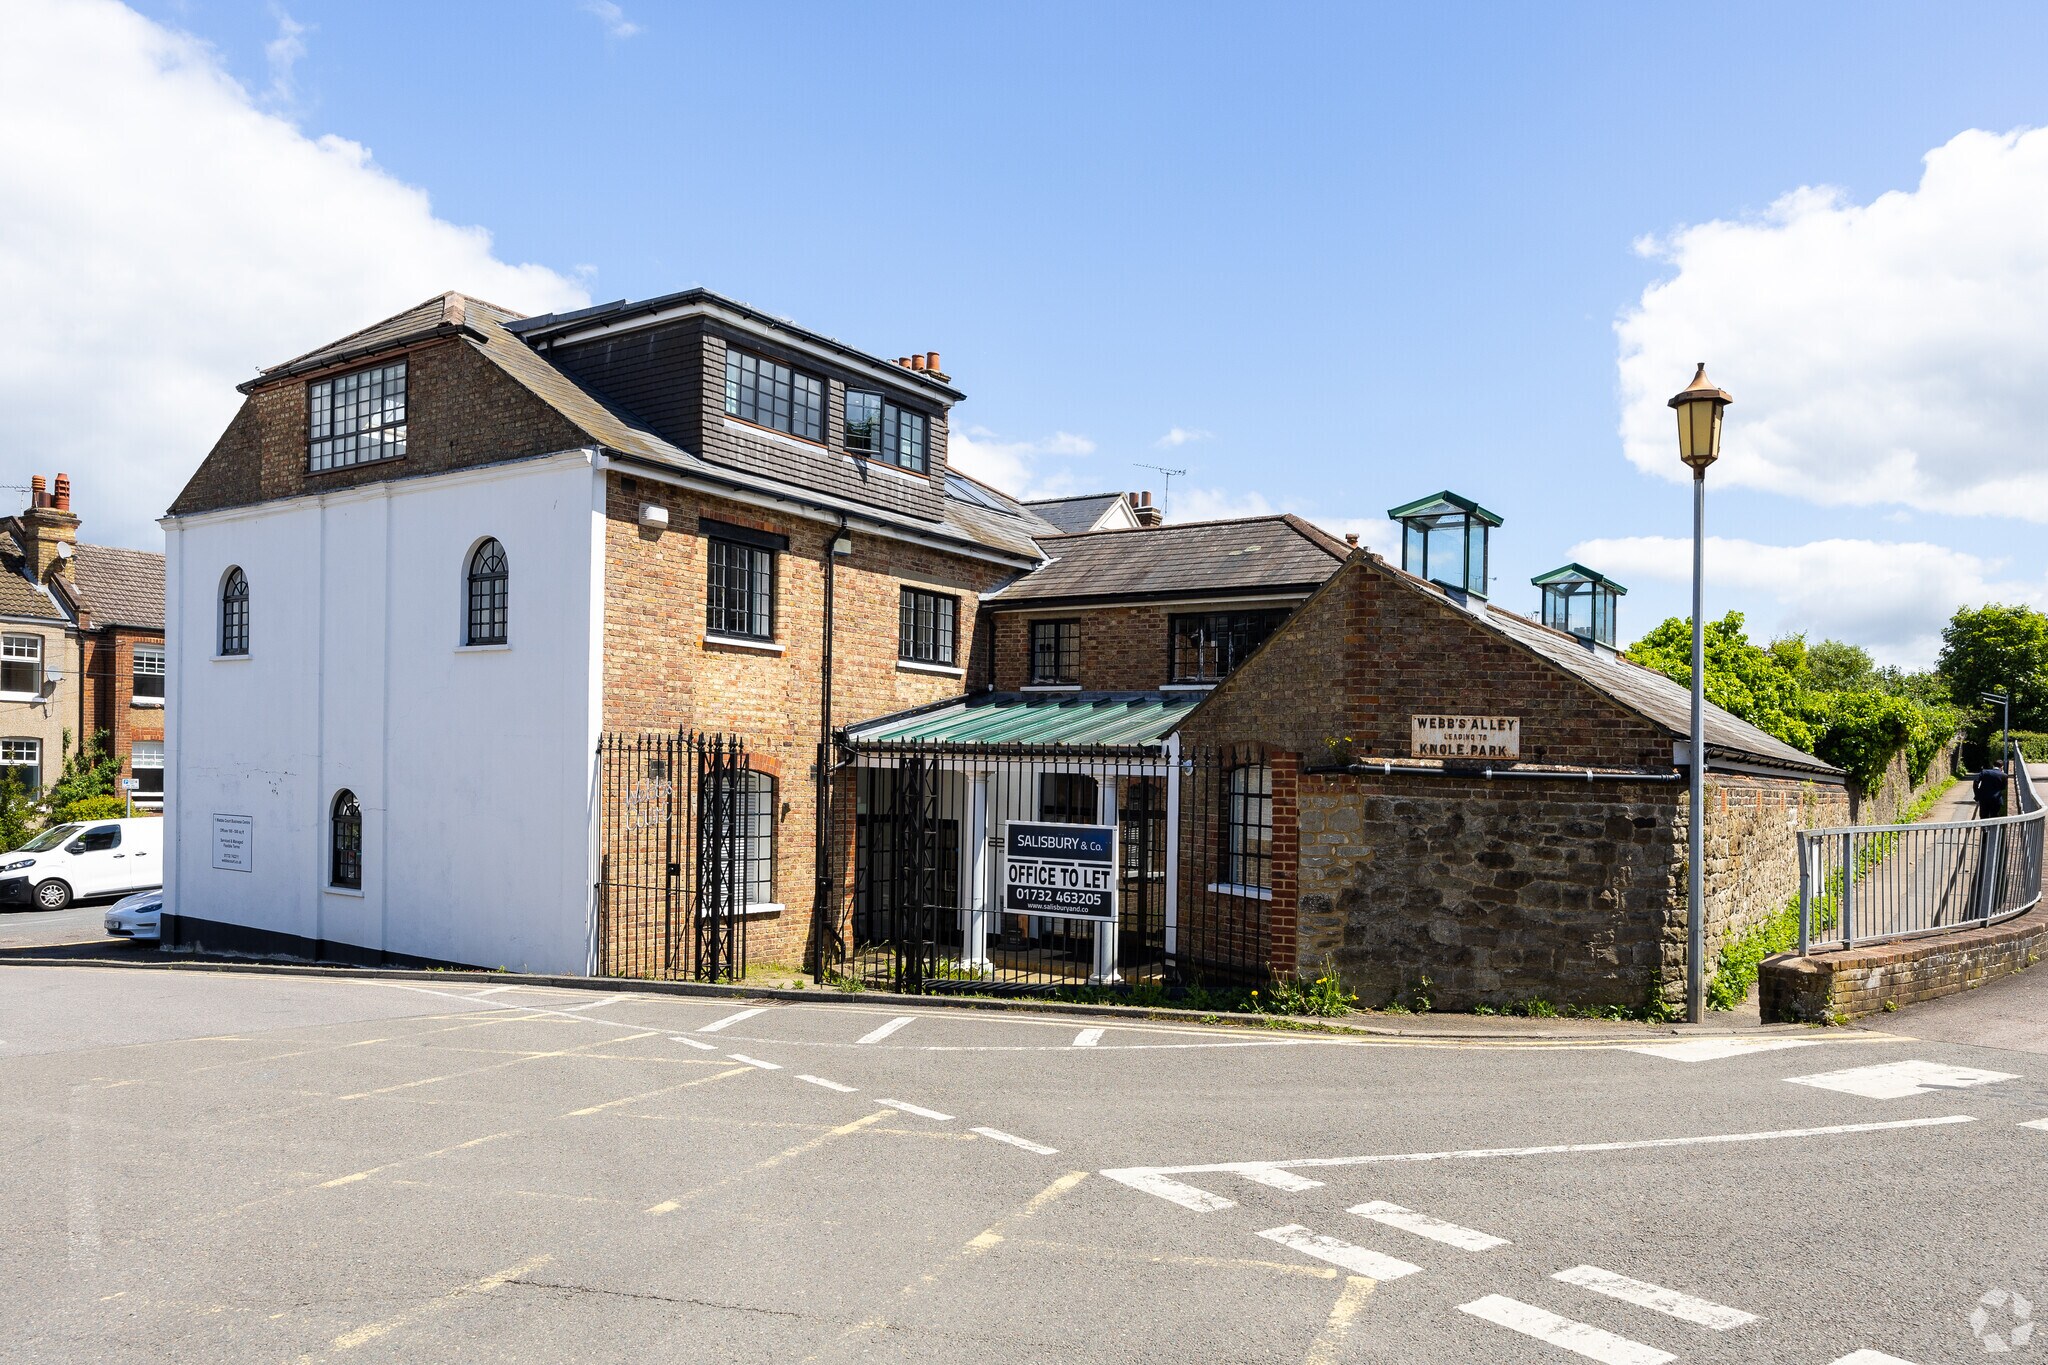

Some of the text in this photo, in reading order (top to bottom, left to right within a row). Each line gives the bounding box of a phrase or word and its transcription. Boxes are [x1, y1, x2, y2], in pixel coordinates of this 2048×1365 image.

[1417, 717, 1515, 731] WEBB'S ALLEY
[1444, 733, 1475, 741] LEADING
[1419, 743, 1507, 757] KNOLE PARK
[1017, 834, 1103, 851] SALISBURY & Co.
[1009, 864, 1110, 890] OFFICE TO LET
[1016, 888, 1102, 906] 01732 463205
[1027, 902, 1089, 912] www.salisburyand.co
